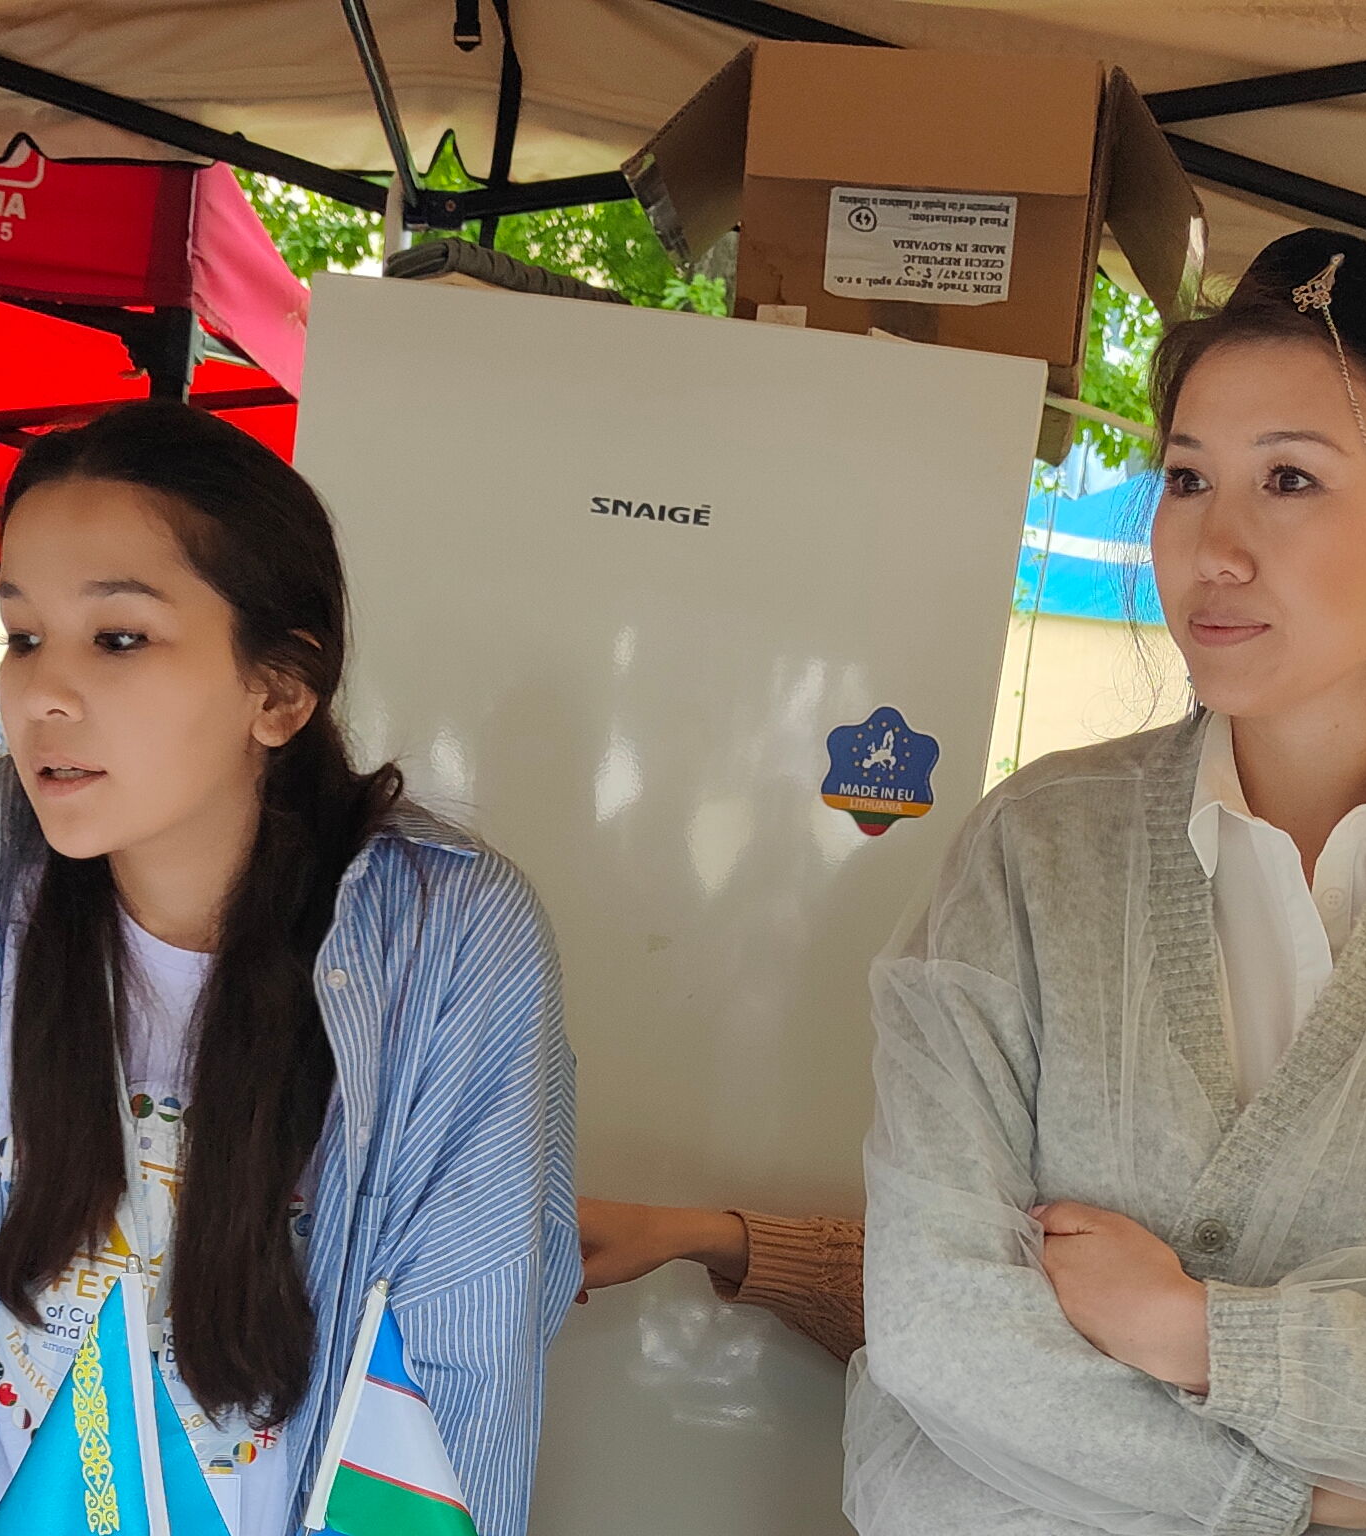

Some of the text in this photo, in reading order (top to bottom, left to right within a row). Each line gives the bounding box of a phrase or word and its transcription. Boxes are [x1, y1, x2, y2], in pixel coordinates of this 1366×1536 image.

[979, 216, 1009, 227] Final
[892, 239, 1006, 254] MADE IN SLOVAKIA
[903, 254, 1004, 268] CZECH REPUBLIC
[895, 277, 934, 290] agency
[937, 282, 968, 292] Trade
[839, 783, 915, 801] MADE IN EU
[849, 798, 902, 812] LITHUANIA
[46, 1305, 64, 1320] of
[45, 1323, 81, 1340] and
[6, 1326, 56, 1402] Tashke
